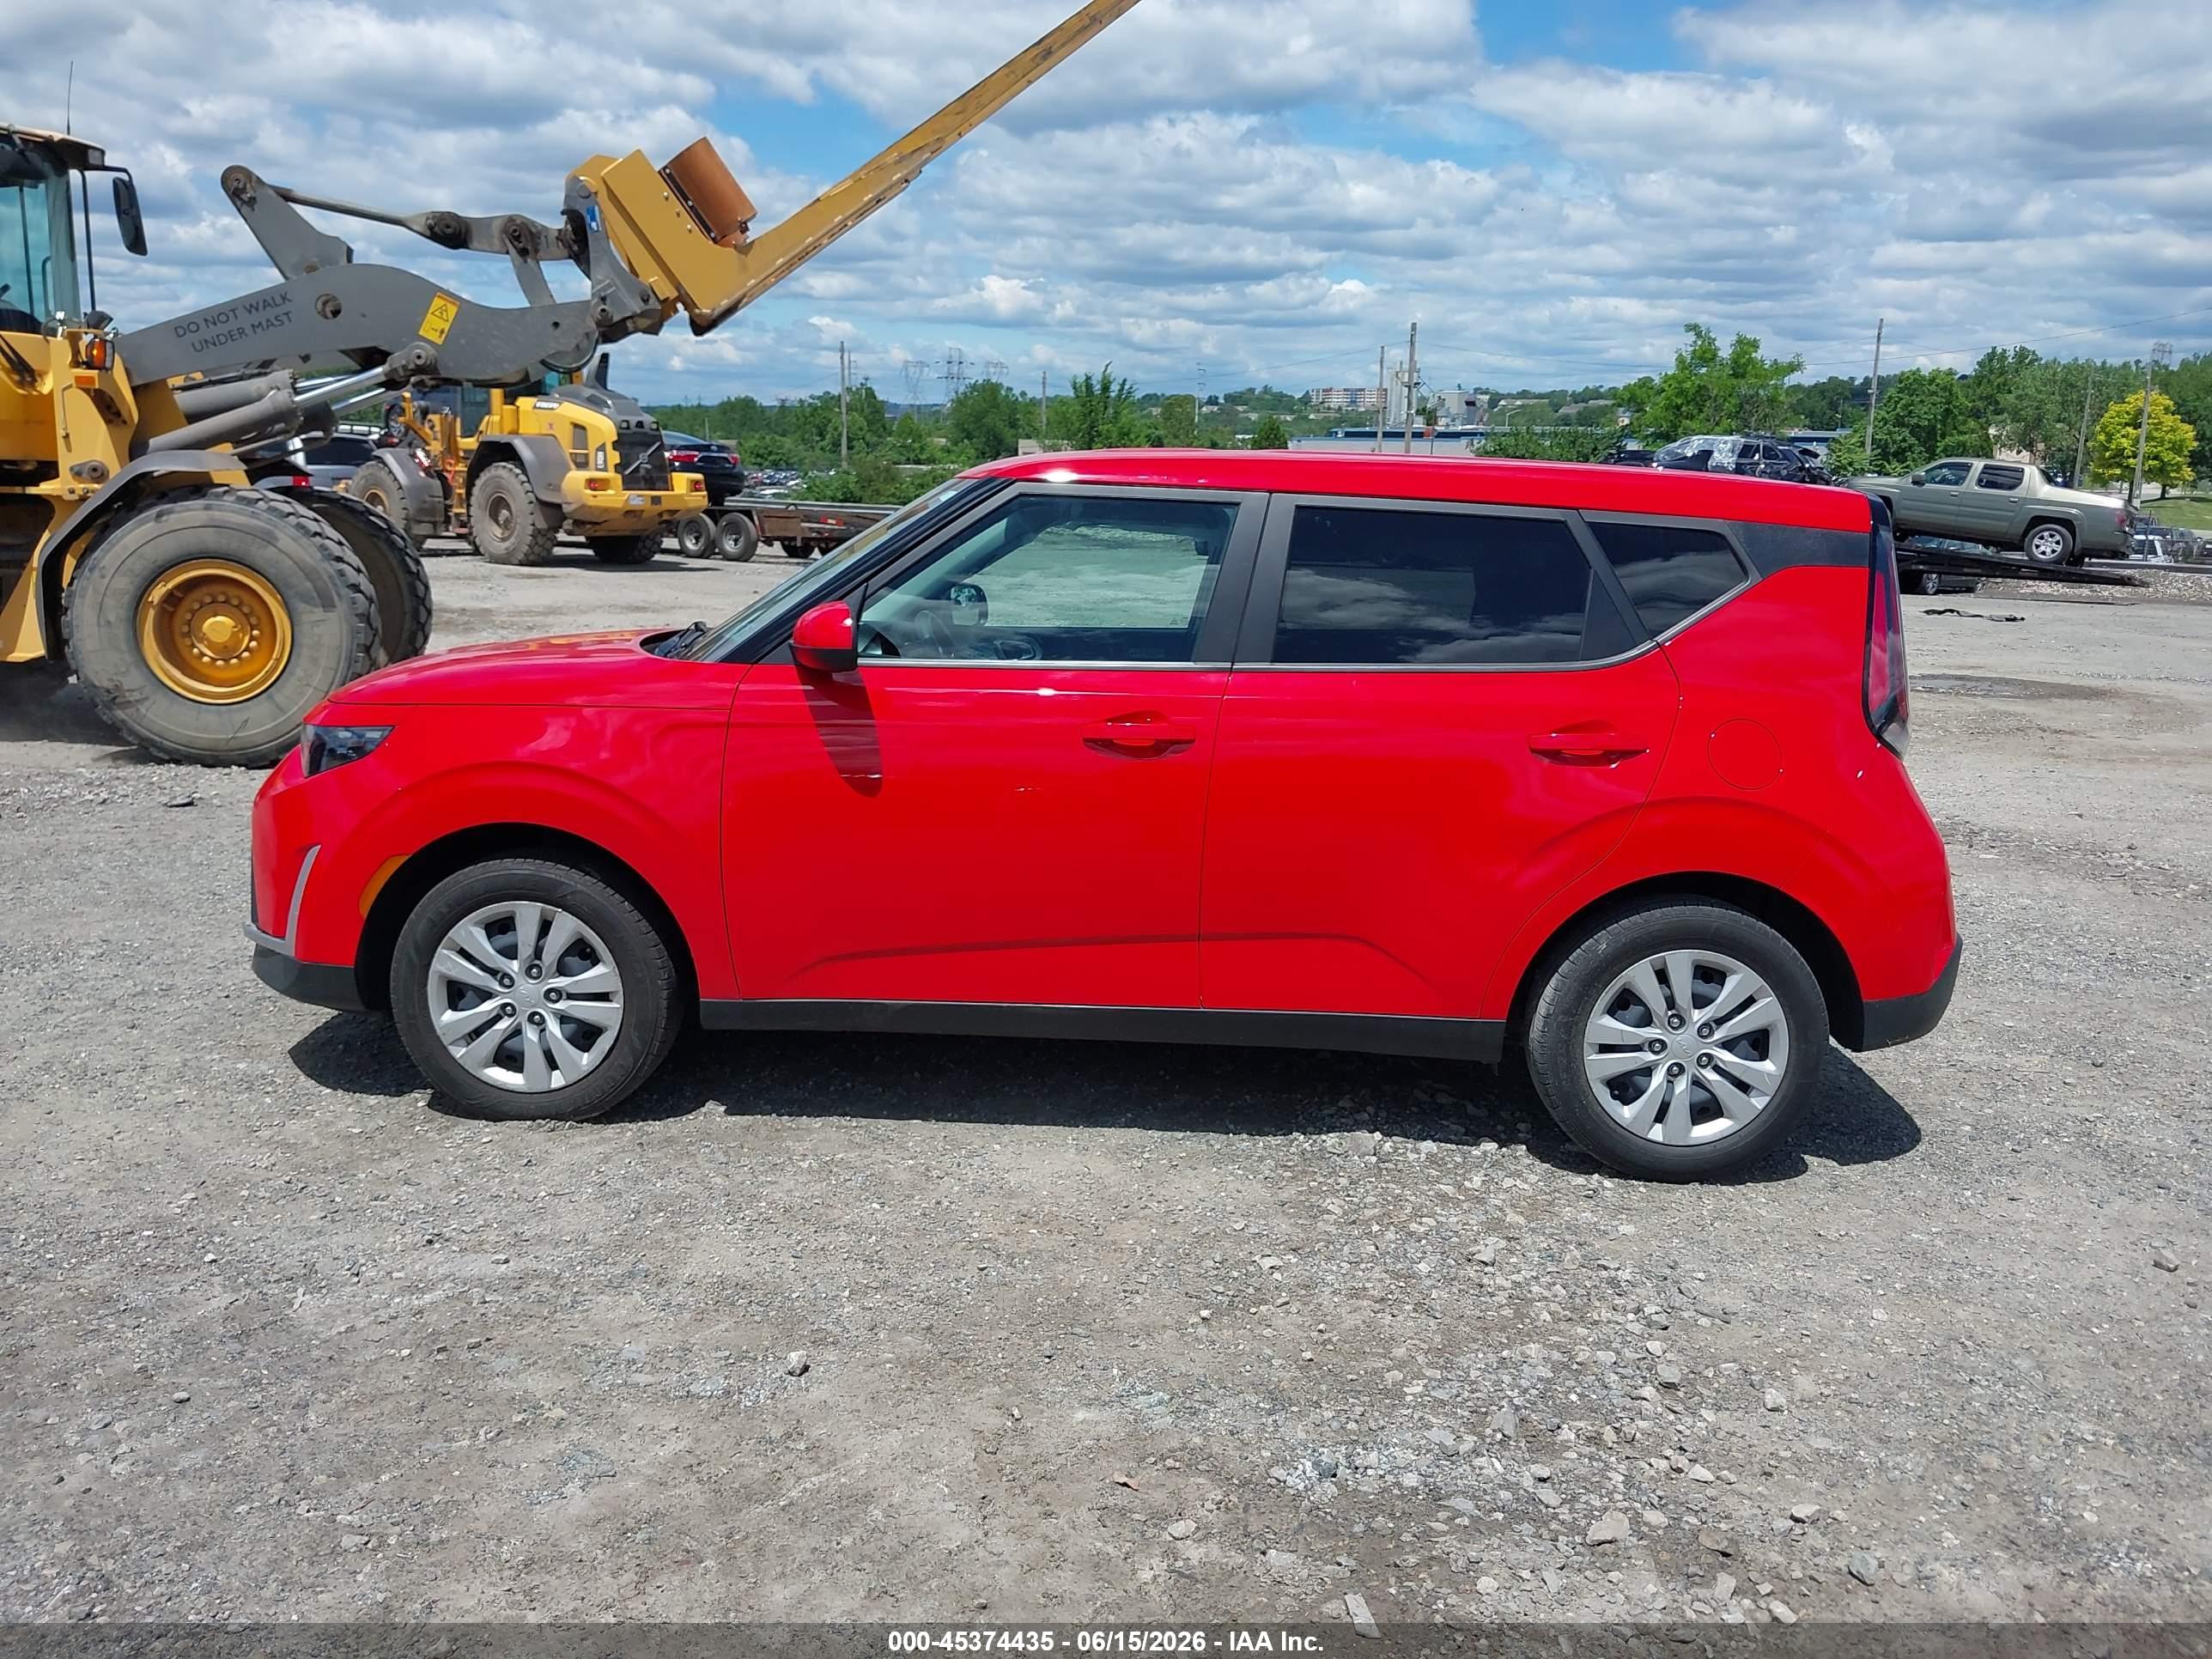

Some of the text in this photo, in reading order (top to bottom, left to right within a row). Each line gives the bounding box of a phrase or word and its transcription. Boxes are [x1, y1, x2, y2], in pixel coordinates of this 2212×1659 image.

[173, 291, 293, 338] DO NOT WALK
[191, 311, 293, 352] UNDER MAST
